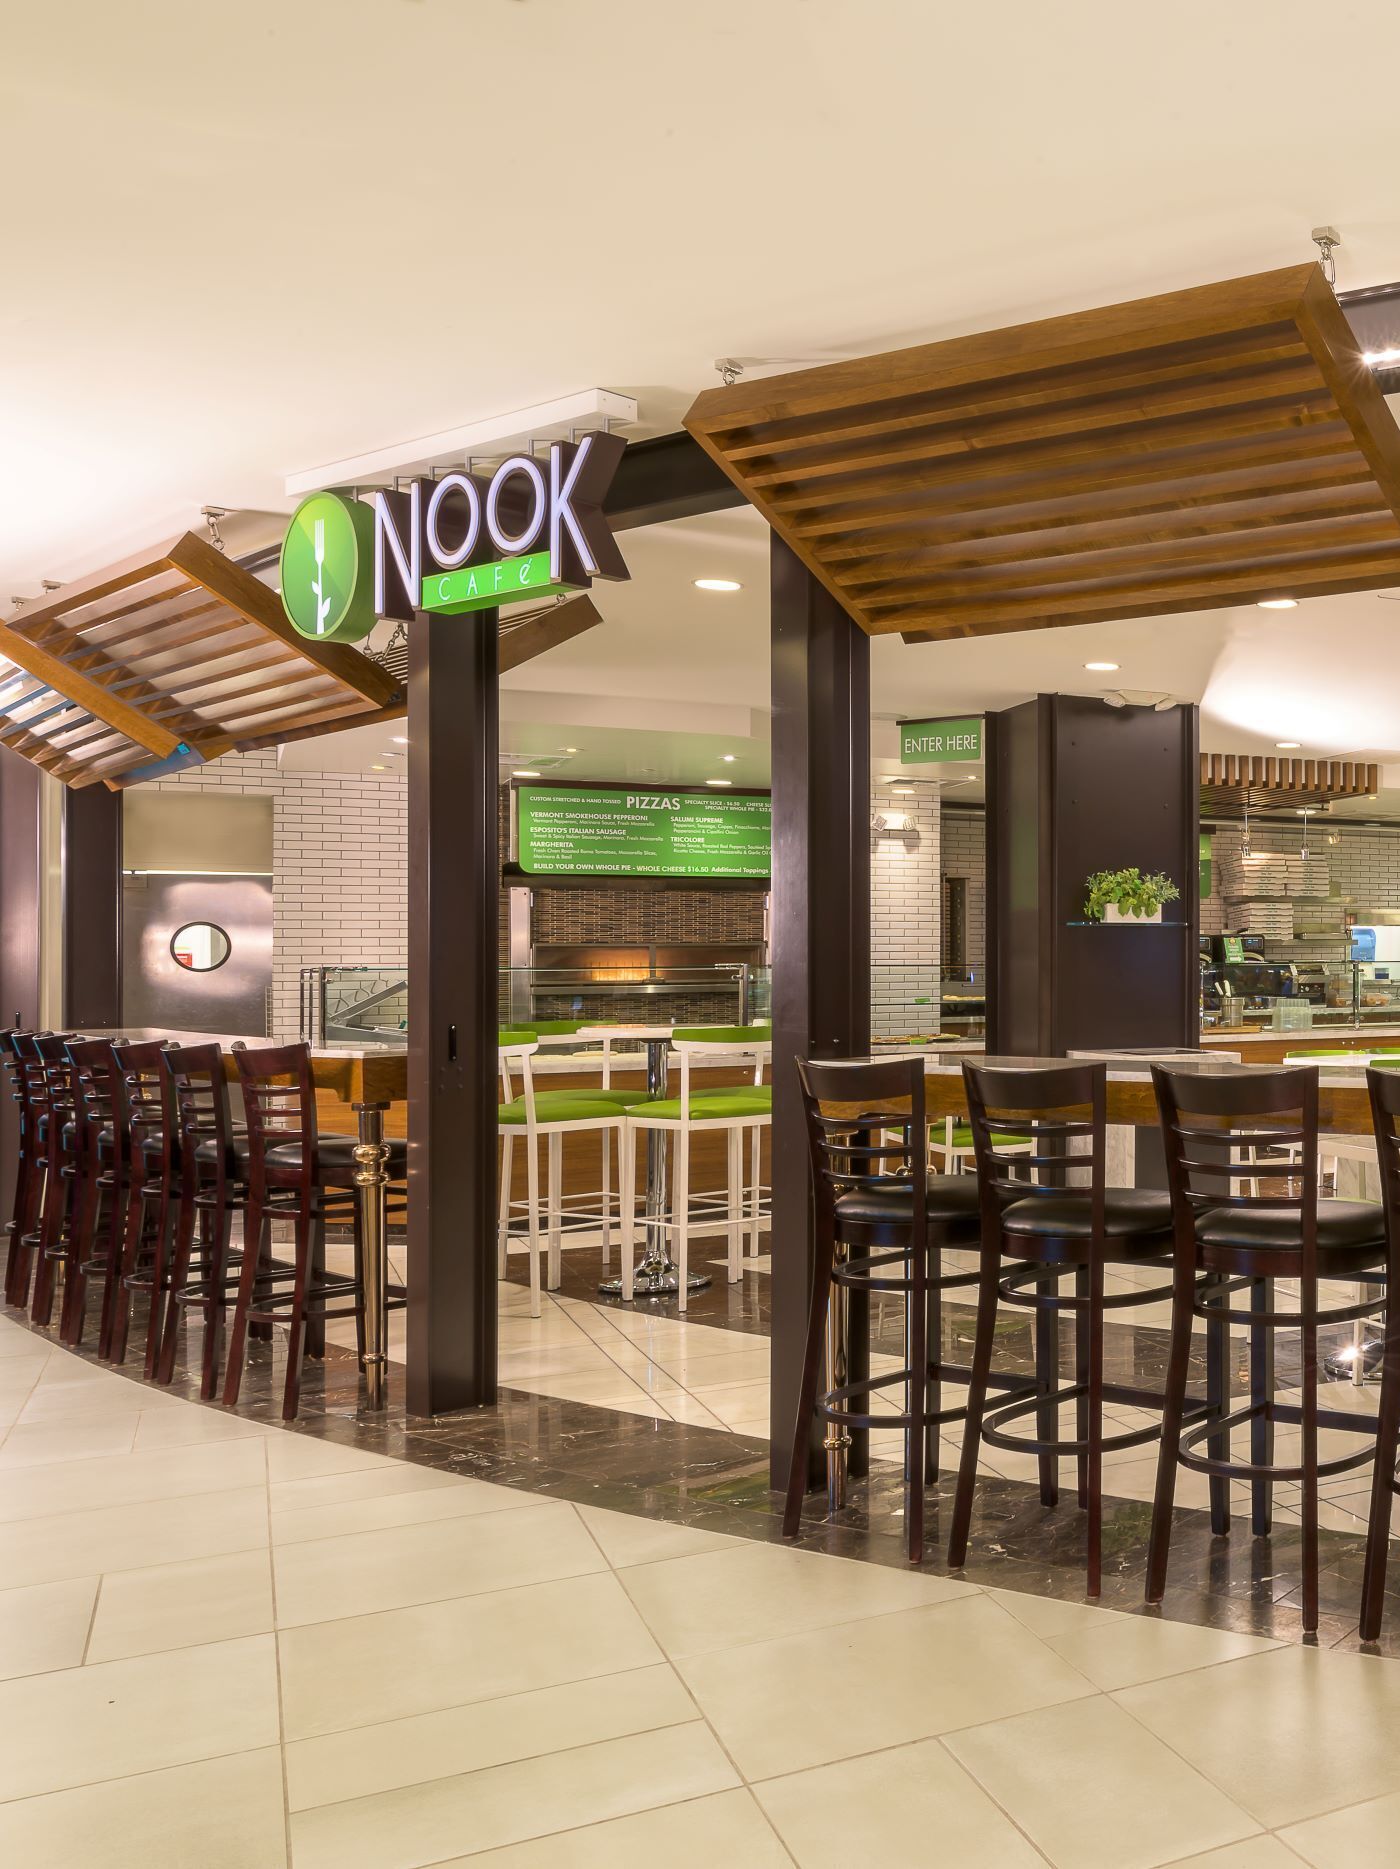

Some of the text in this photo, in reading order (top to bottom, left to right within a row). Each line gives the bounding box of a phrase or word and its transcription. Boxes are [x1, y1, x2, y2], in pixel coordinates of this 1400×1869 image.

[374, 435, 600, 616] NOOK
[904, 734, 977, 753] ENTER HERE
[626, 796, 680, 810] PIZZAS
